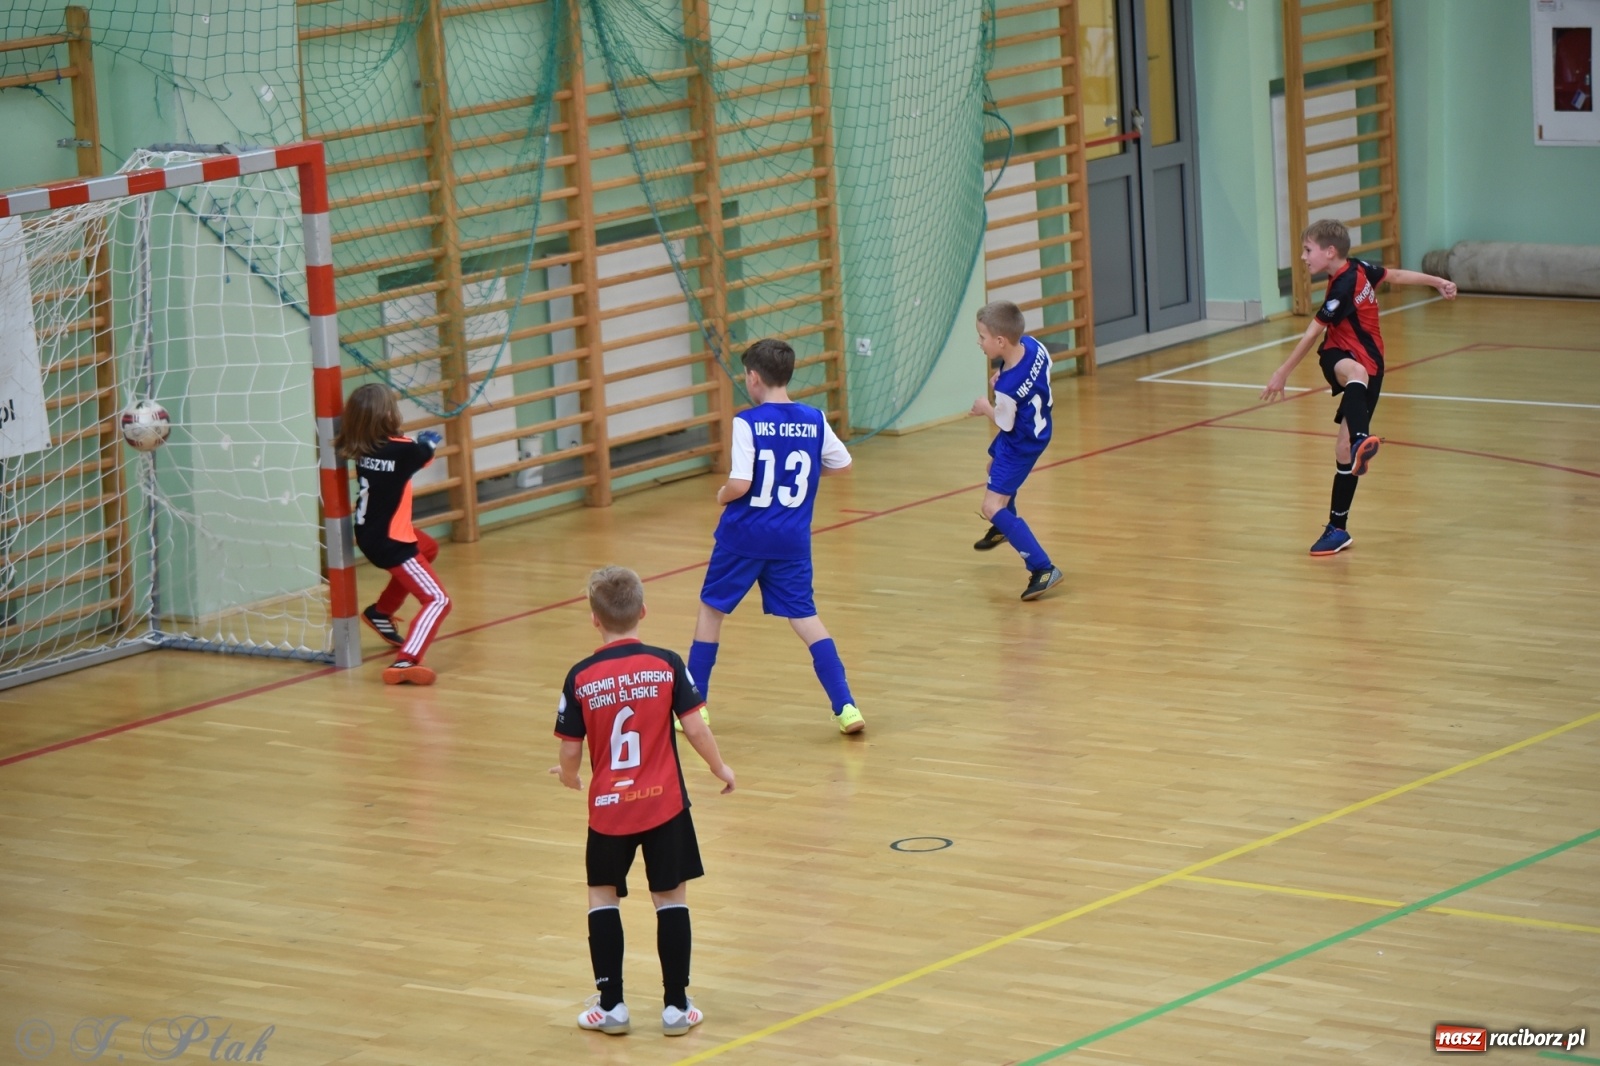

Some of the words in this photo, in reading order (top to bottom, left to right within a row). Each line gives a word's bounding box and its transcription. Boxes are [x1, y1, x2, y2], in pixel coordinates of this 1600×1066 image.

[1016, 378, 1033, 398] UKS
[754, 422, 776, 436] UKS
[779, 423, 818, 438] CIESZYN
[749, 449, 812, 508] 13
[618, 671, 673, 687] PIŁKARSKA
[588, 692, 617, 710] GÓRKI
[610, 705, 641, 771] 6
